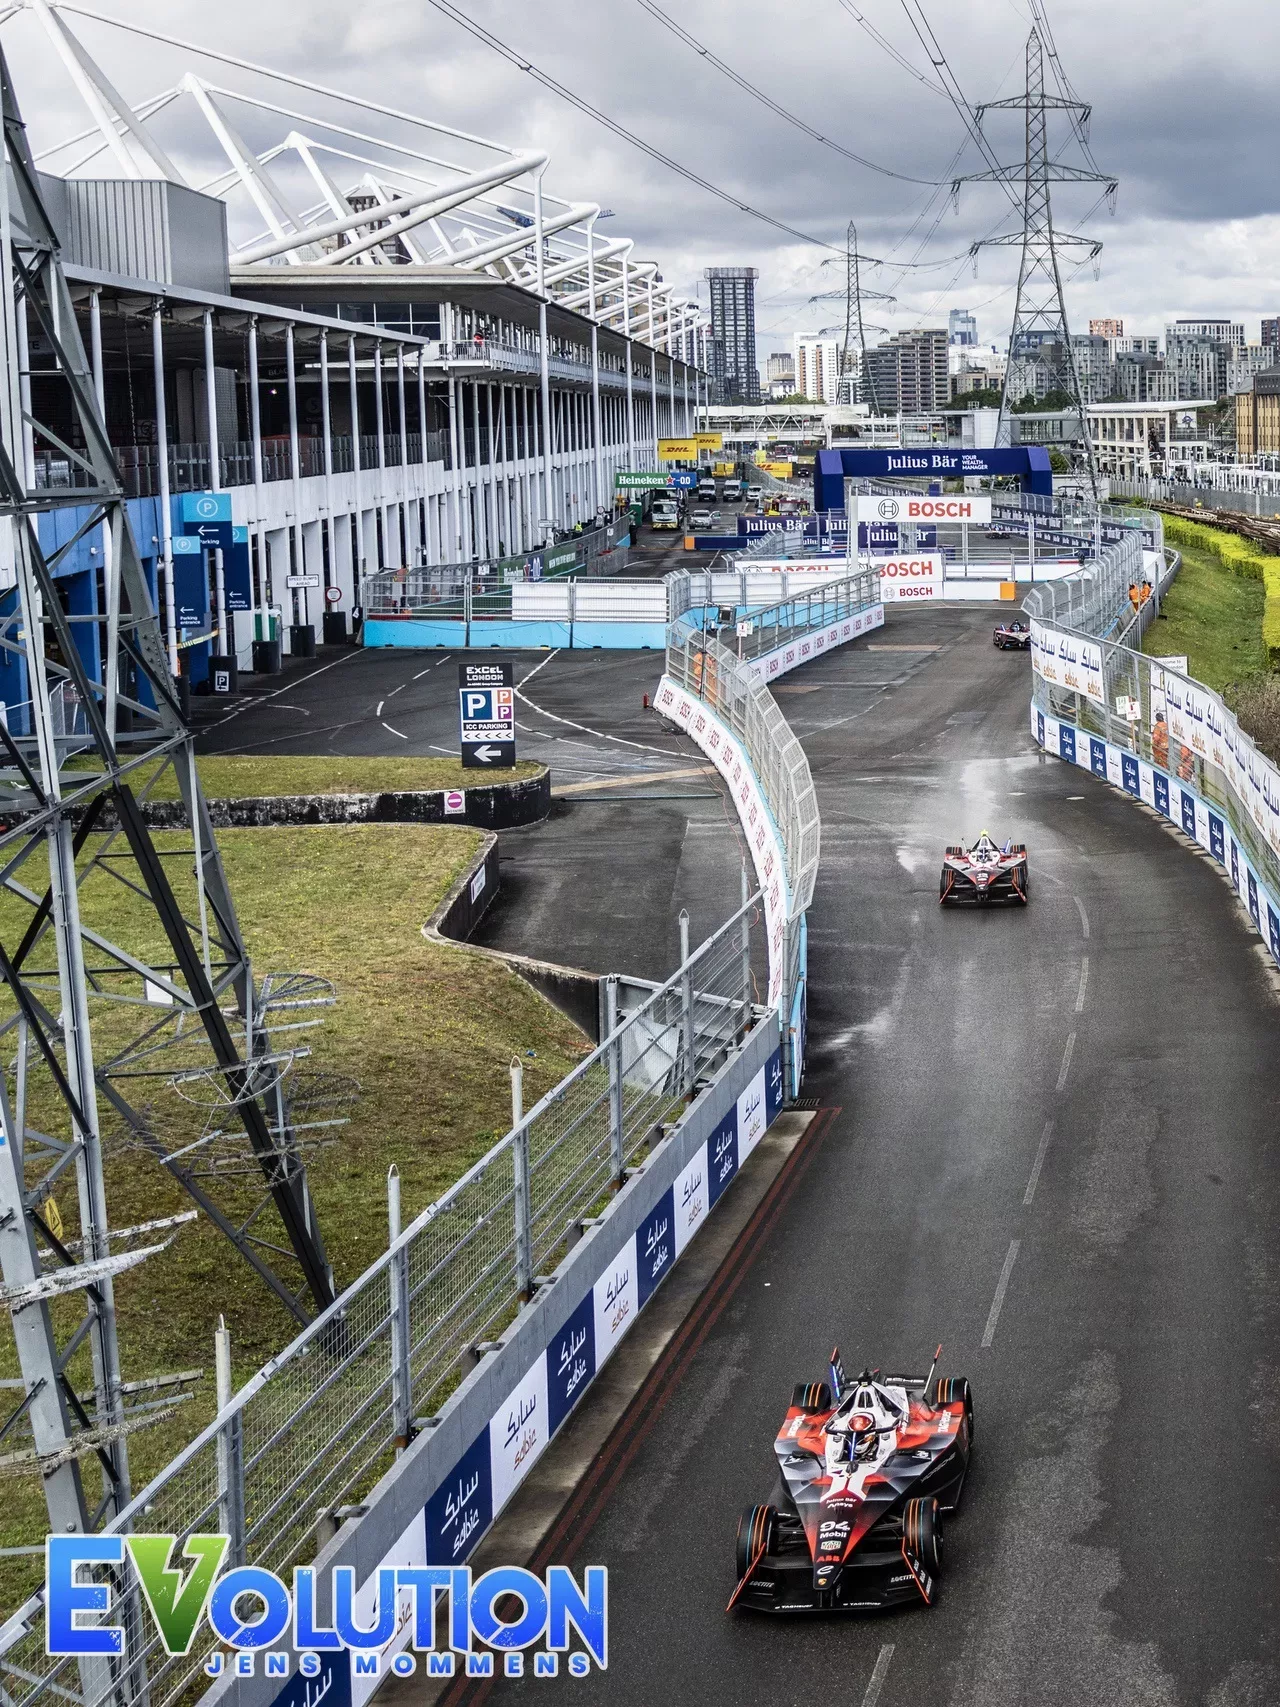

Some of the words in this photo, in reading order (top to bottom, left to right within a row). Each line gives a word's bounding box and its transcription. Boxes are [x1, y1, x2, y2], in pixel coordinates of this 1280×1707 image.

[887, 455, 928, 471] Julius
[931, 455, 958, 468] Bär
[618, 475, 664, 485] Heineken
[204, 503, 212, 512] P
[908, 502, 971, 517] BOSCH
[746, 519, 783, 533] Julius
[786, 519, 809, 531] Bär
[825, 519, 848, 533] Juli
[899, 587, 933, 597] BOSCH
[1081, 647, 1099, 675] سابك
[467, 693, 486, 718] P
[500, 691, 509, 703] P
[500, 706, 510, 719] P
[744, 1094, 760, 1124] سابك
[714, 1131, 732, 1164] سابك
[720, 1154, 733, 1182] sabic
[682, 1172, 701, 1208] سابك
[688, 1198, 702, 1227] sabic
[645, 1218, 668, 1258] سابك
[652, 1244, 668, 1278] sabic
[604, 1270, 628, 1313] سابك
[612, 1300, 630, 1334] sabic
[558, 1326, 586, 1376] سابك
[566, 1357, 587, 1398] sabic
[503, 1394, 536, 1449] سابك
[513, 1428, 536, 1470] sabic
[440, 1470, 479, 1535] سابك
[452, 1506, 479, 1558] sabic
[820, 1521, 850, 1532] 94
[820, 1531, 847, 1539] Mobil
[816, 1554, 840, 1563] ABB
[749, 1580, 775, 1588] LOCTITE
